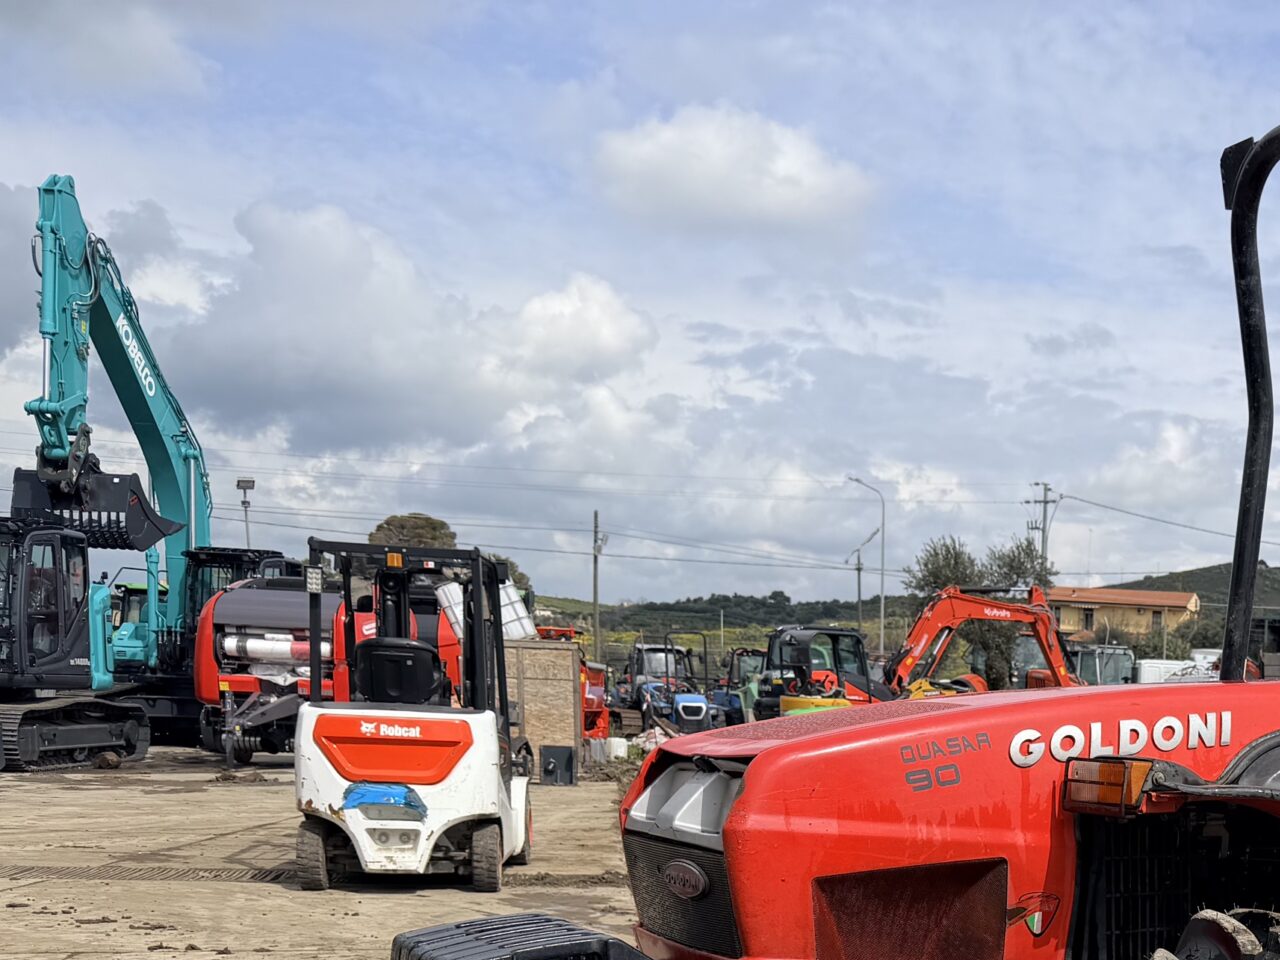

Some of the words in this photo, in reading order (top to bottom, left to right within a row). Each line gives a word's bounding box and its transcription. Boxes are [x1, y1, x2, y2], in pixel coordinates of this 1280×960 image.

[116, 312, 156, 397] KOBELCO
[380, 724, 421, 737] Bobcat
[1009, 711, 1232, 768] GOLDONI
[900, 732, 992, 764] QUASAR
[905, 763, 961, 792] 90
